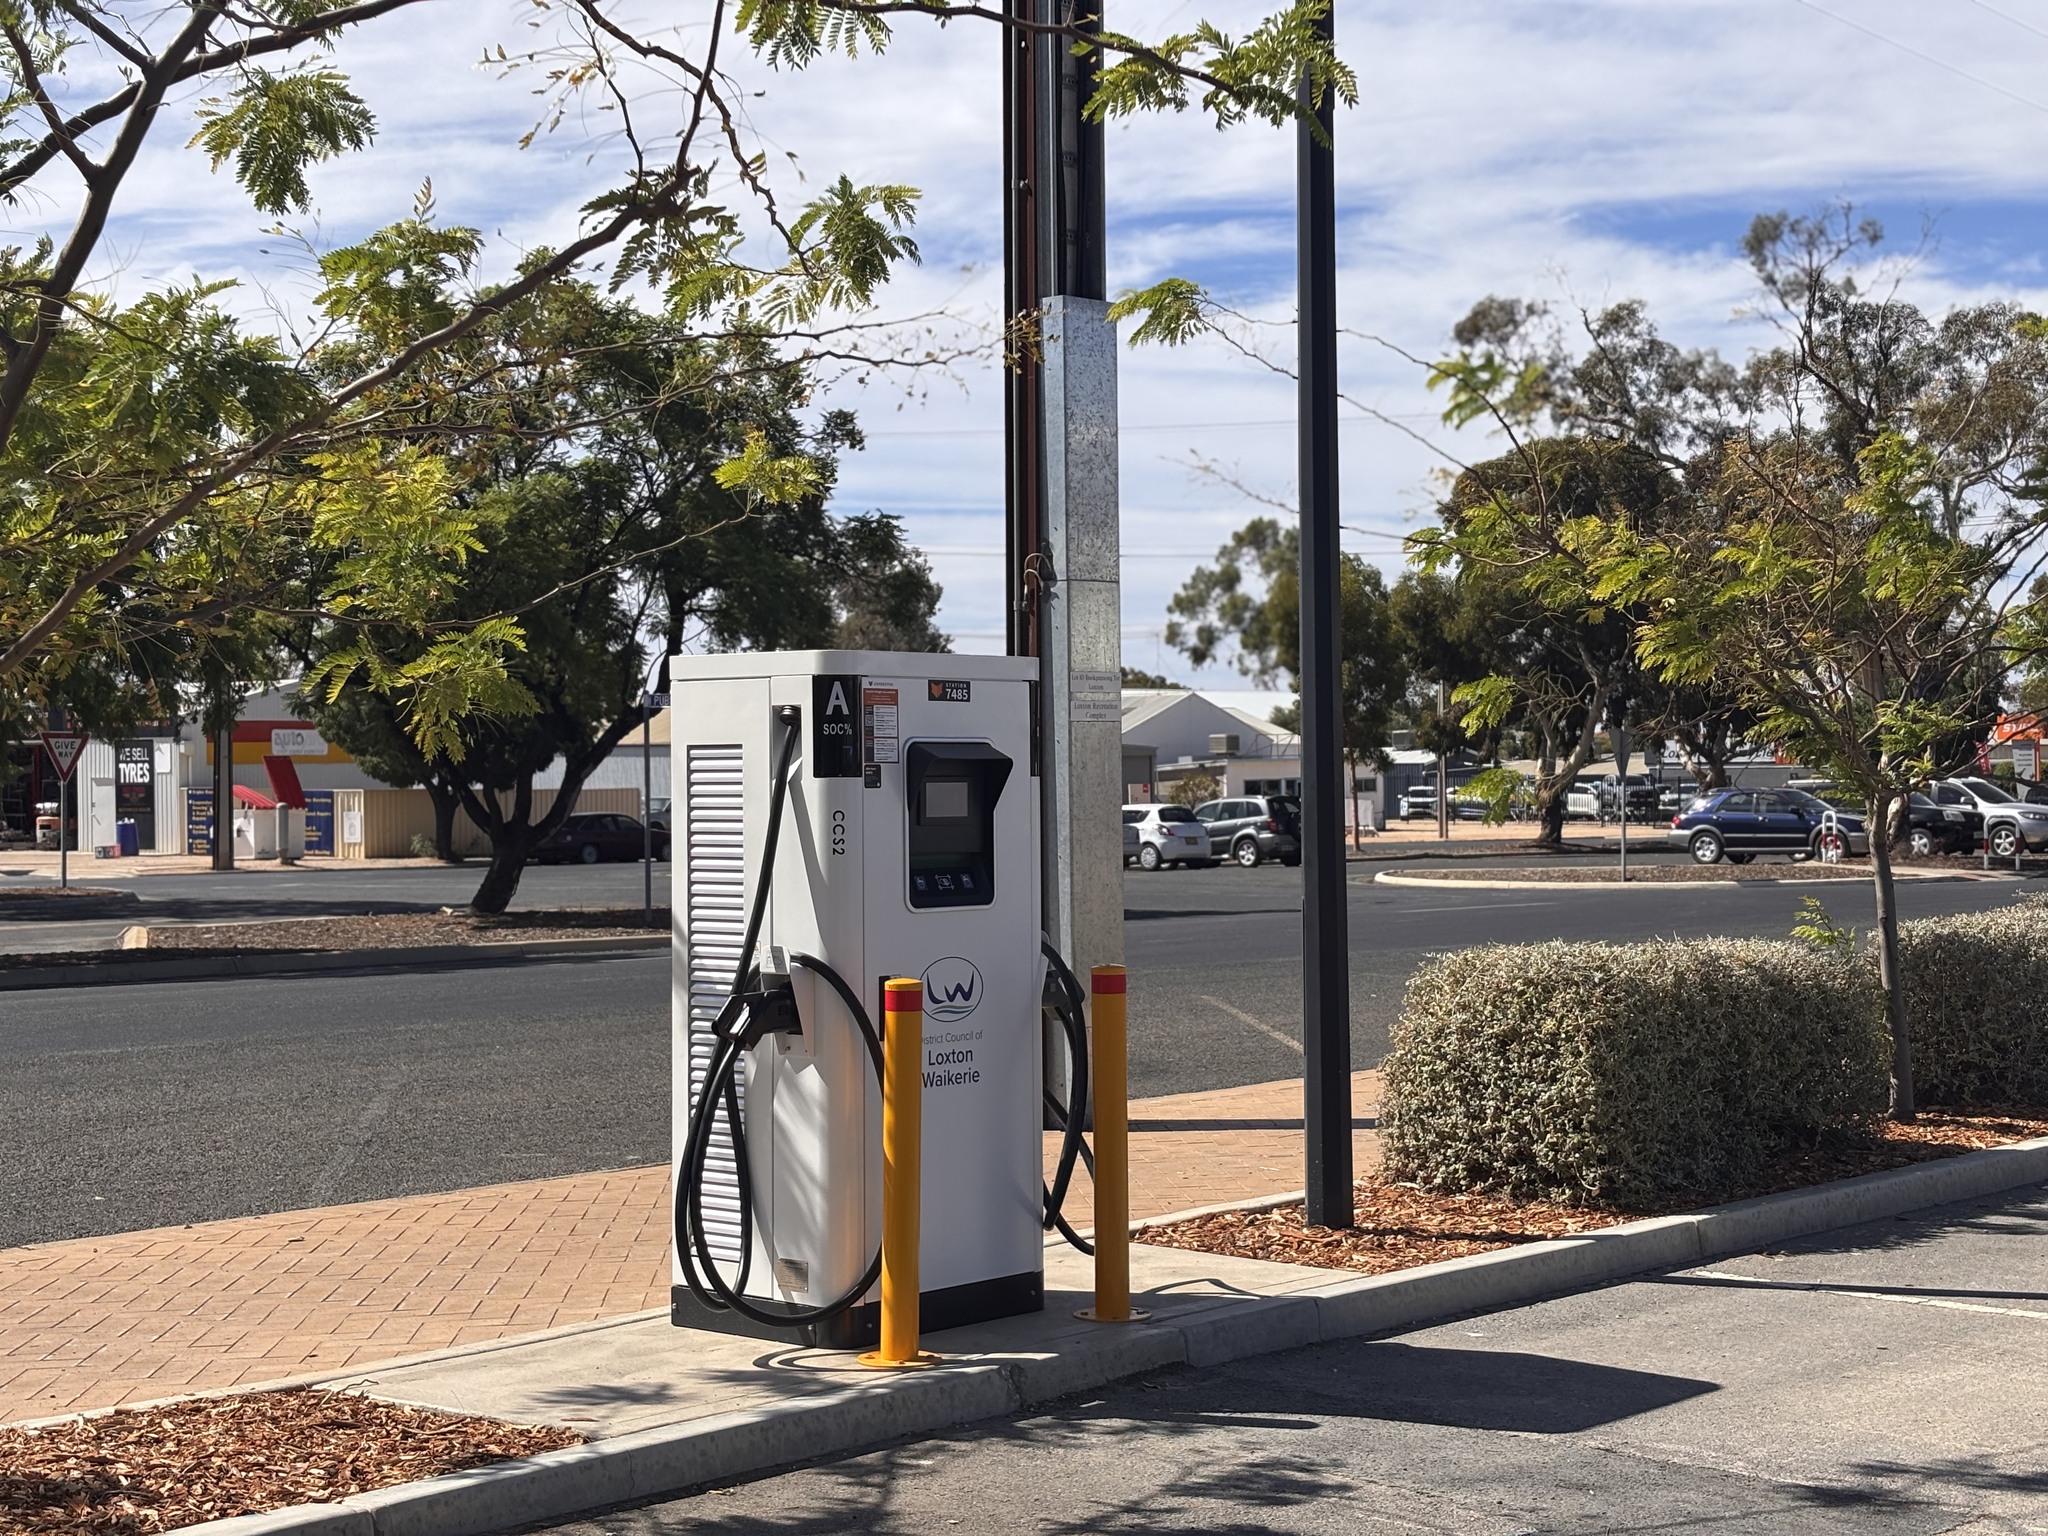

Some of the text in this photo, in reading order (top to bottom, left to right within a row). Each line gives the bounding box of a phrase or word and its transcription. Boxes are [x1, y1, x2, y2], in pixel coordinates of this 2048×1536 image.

[653, 695, 670, 706] PUB
[825, 680, 850, 716] A
[945, 688, 969, 701] 7485
[1074, 701, 1092, 710] Loxton
[823, 723, 853, 735] SOC%
[54, 740, 76, 750] GIVE
[58, 750, 73, 758] WAY
[120, 747, 149, 761] WE SELL
[118, 762, 150, 783] TYRES
[832, 810, 845, 855] CCS2
[921, 1030, 983, 1046] istrict Council of
[927, 1048, 974, 1066] Loxton
[921, 1067, 981, 1089] Waikerie
